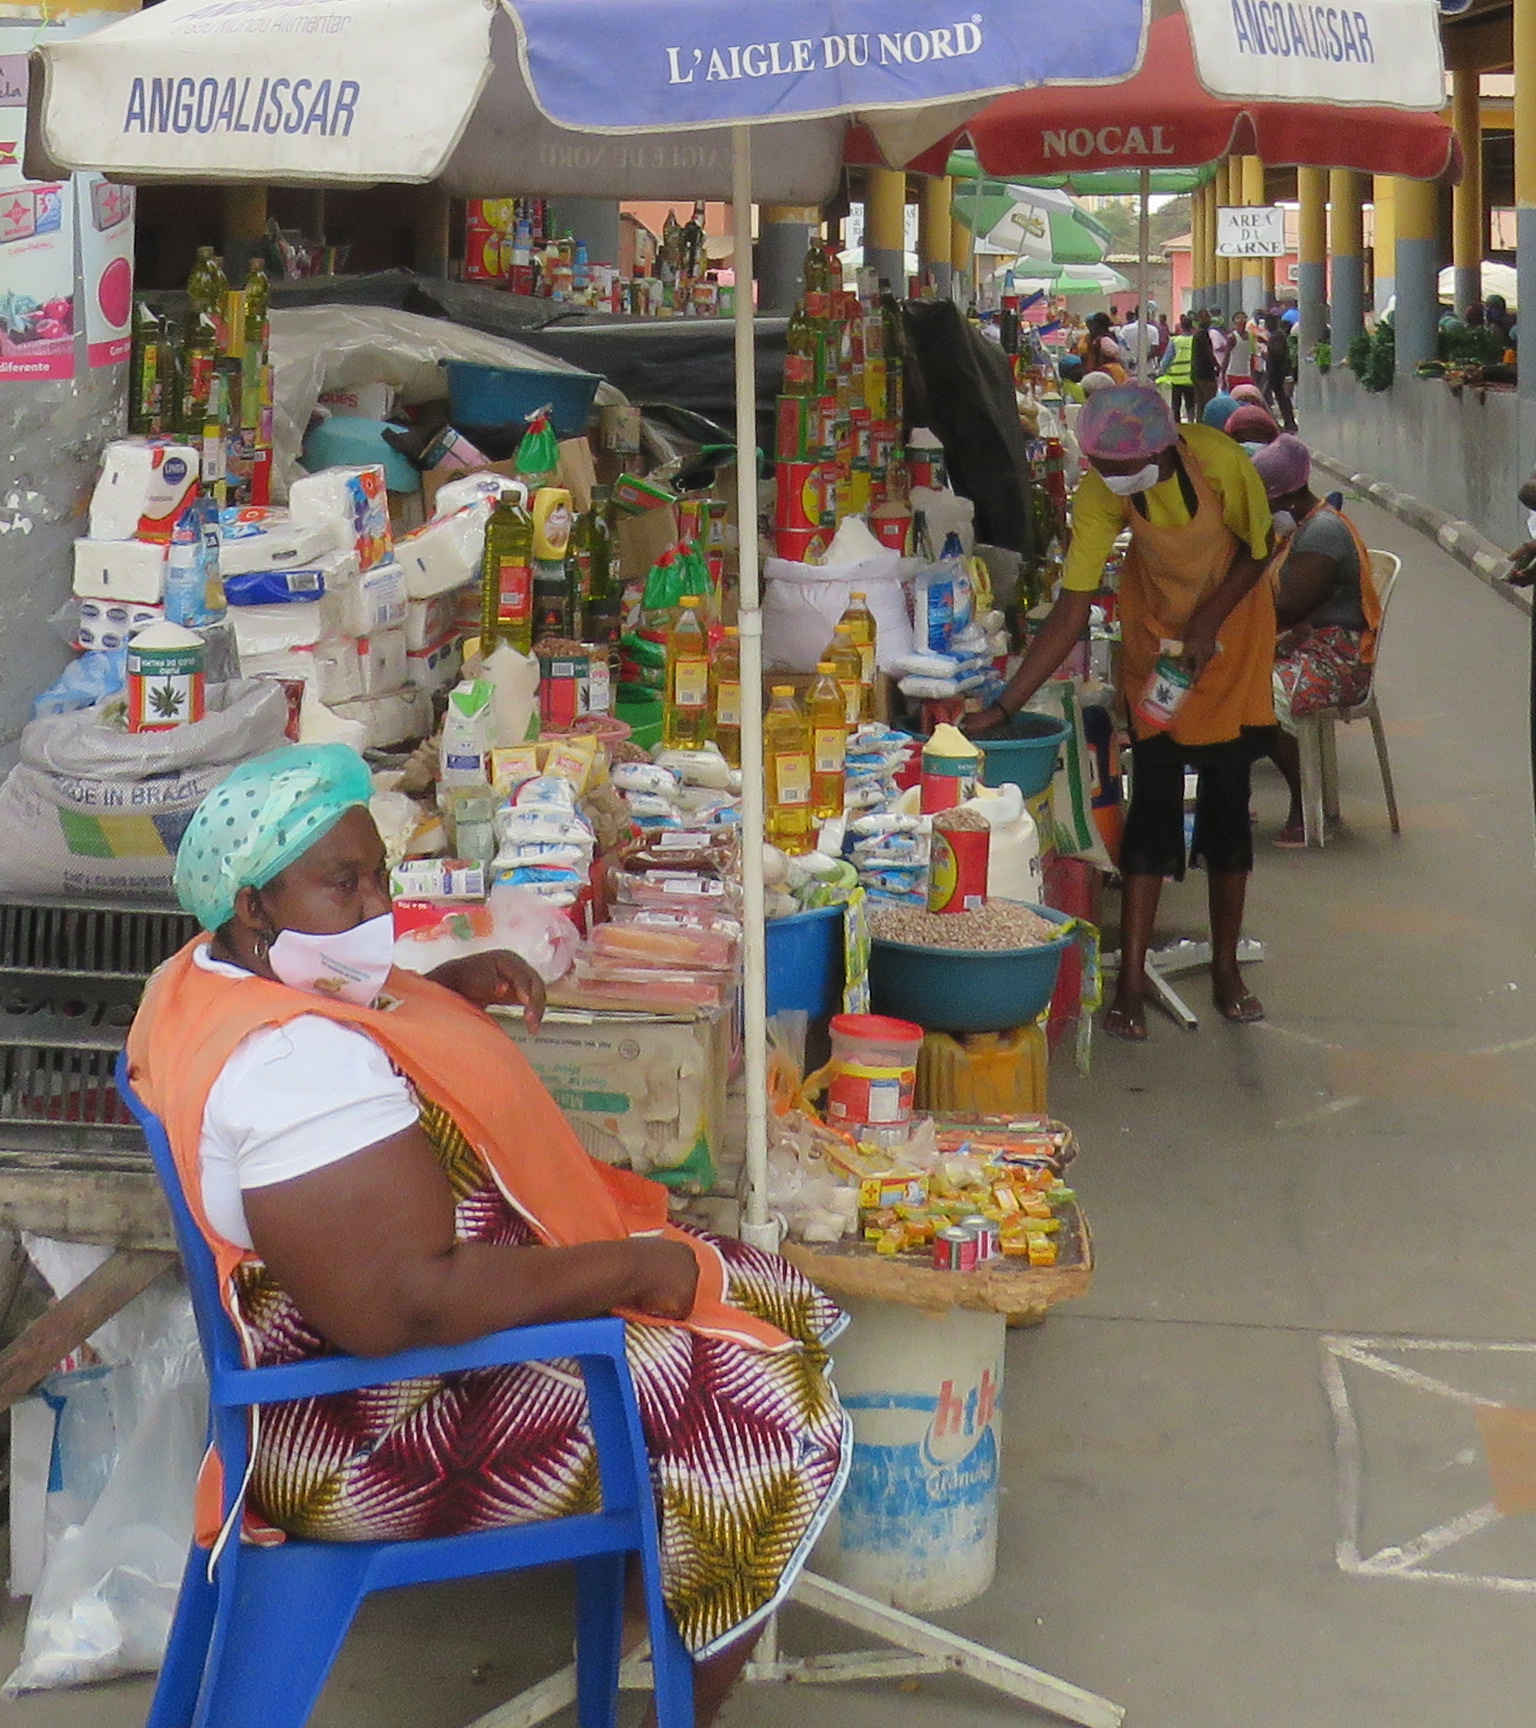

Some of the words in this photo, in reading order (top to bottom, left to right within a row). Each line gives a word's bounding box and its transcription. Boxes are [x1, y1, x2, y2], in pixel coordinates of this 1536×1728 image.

[666, 39, 815, 84] L'AIGLE
[822, 33, 869, 69] DU
[878, 20, 983, 65] NORD
[123, 78, 360, 136] ANGOALISSAR
[1041, 126, 1175, 159] NOCAL
[1229, 214, 1273, 228] AREA
[1220, 241, 1282, 254] CARNE
[104, 783, 124, 807] IN
[132, 779, 206, 805] BRAZIL
